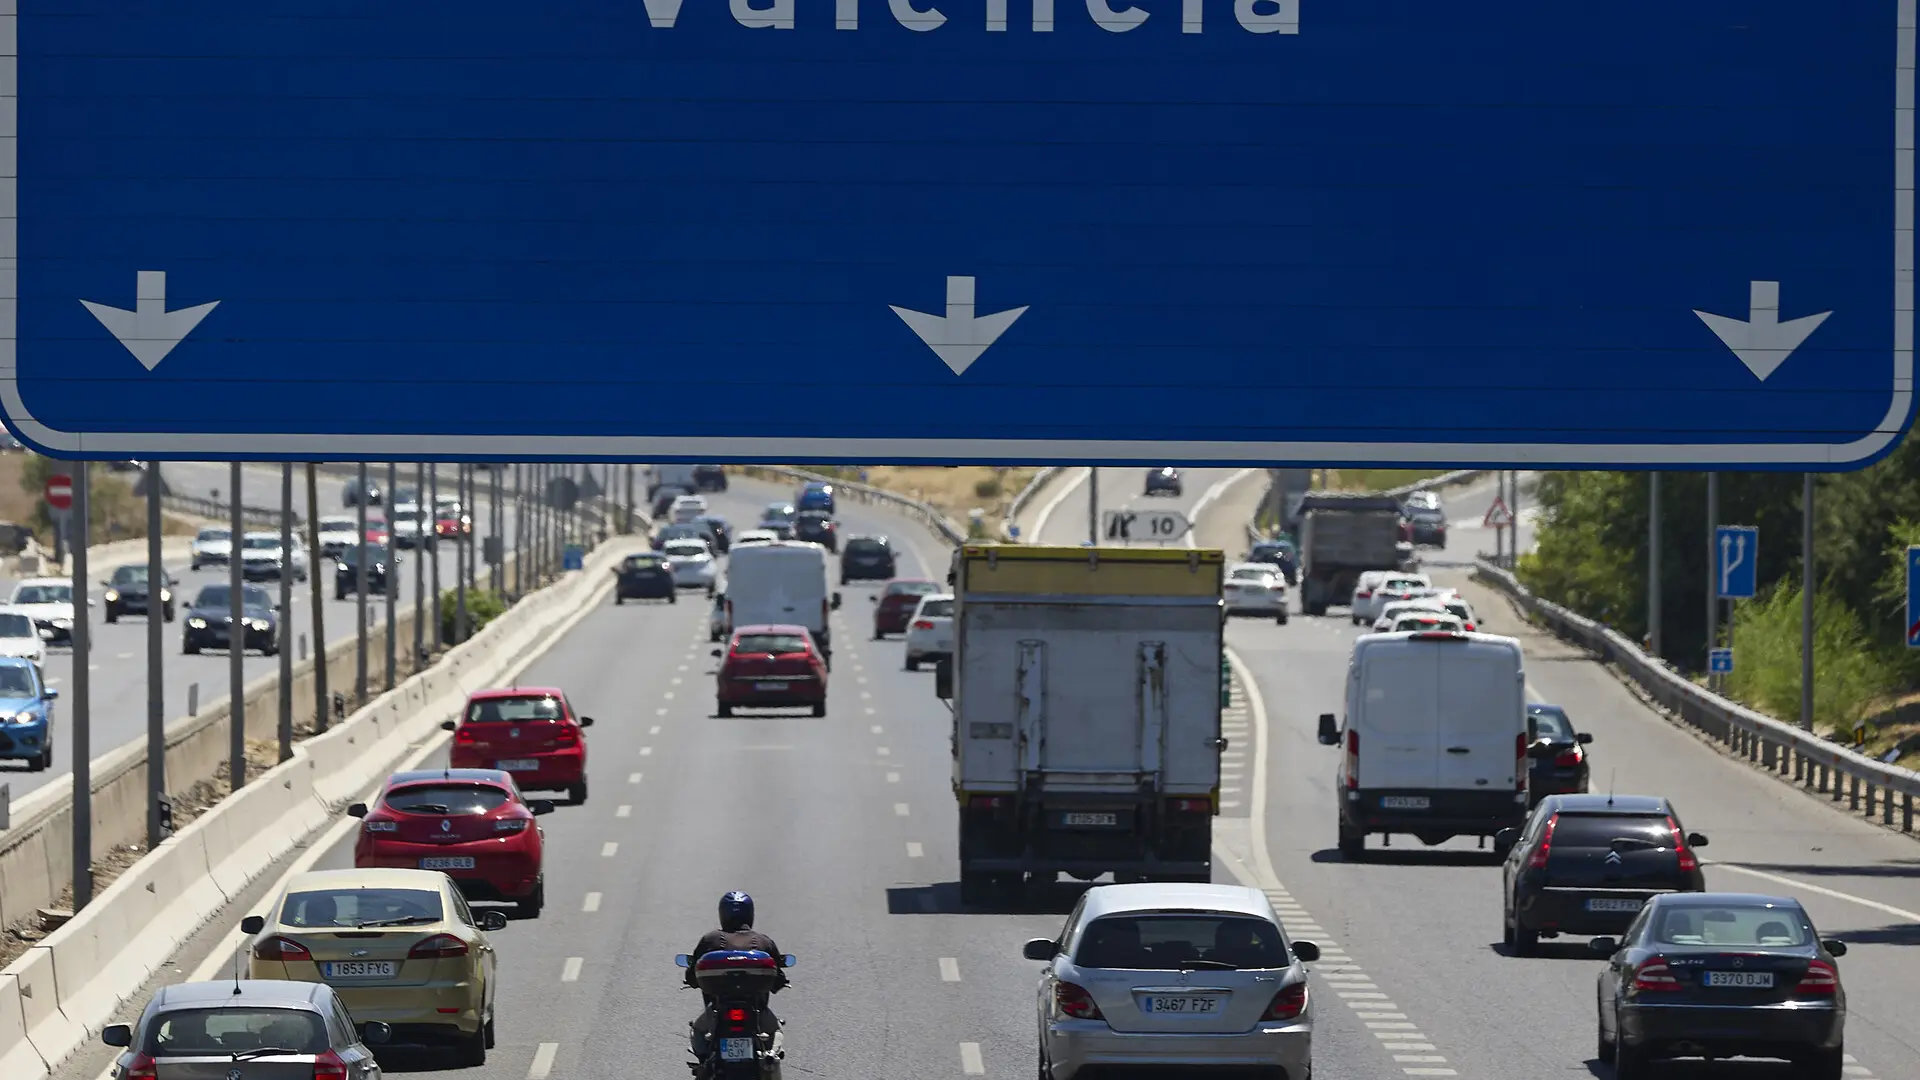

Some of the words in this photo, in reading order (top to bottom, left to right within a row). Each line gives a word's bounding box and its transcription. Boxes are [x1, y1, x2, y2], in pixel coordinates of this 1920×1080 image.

[1151, 517, 1174, 535] 10
[336, 963, 365, 975] 1853
[367, 962, 390, 975] FYG
[1712, 972, 1744, 985] 3370
[1746, 973, 1771, 986] DJM
[1155, 998, 1185, 1012] 3467
[1191, 998, 1216, 1012] FZF
[727, 1038, 751, 1048] 4671
[727, 1047, 745, 1058] GJY
